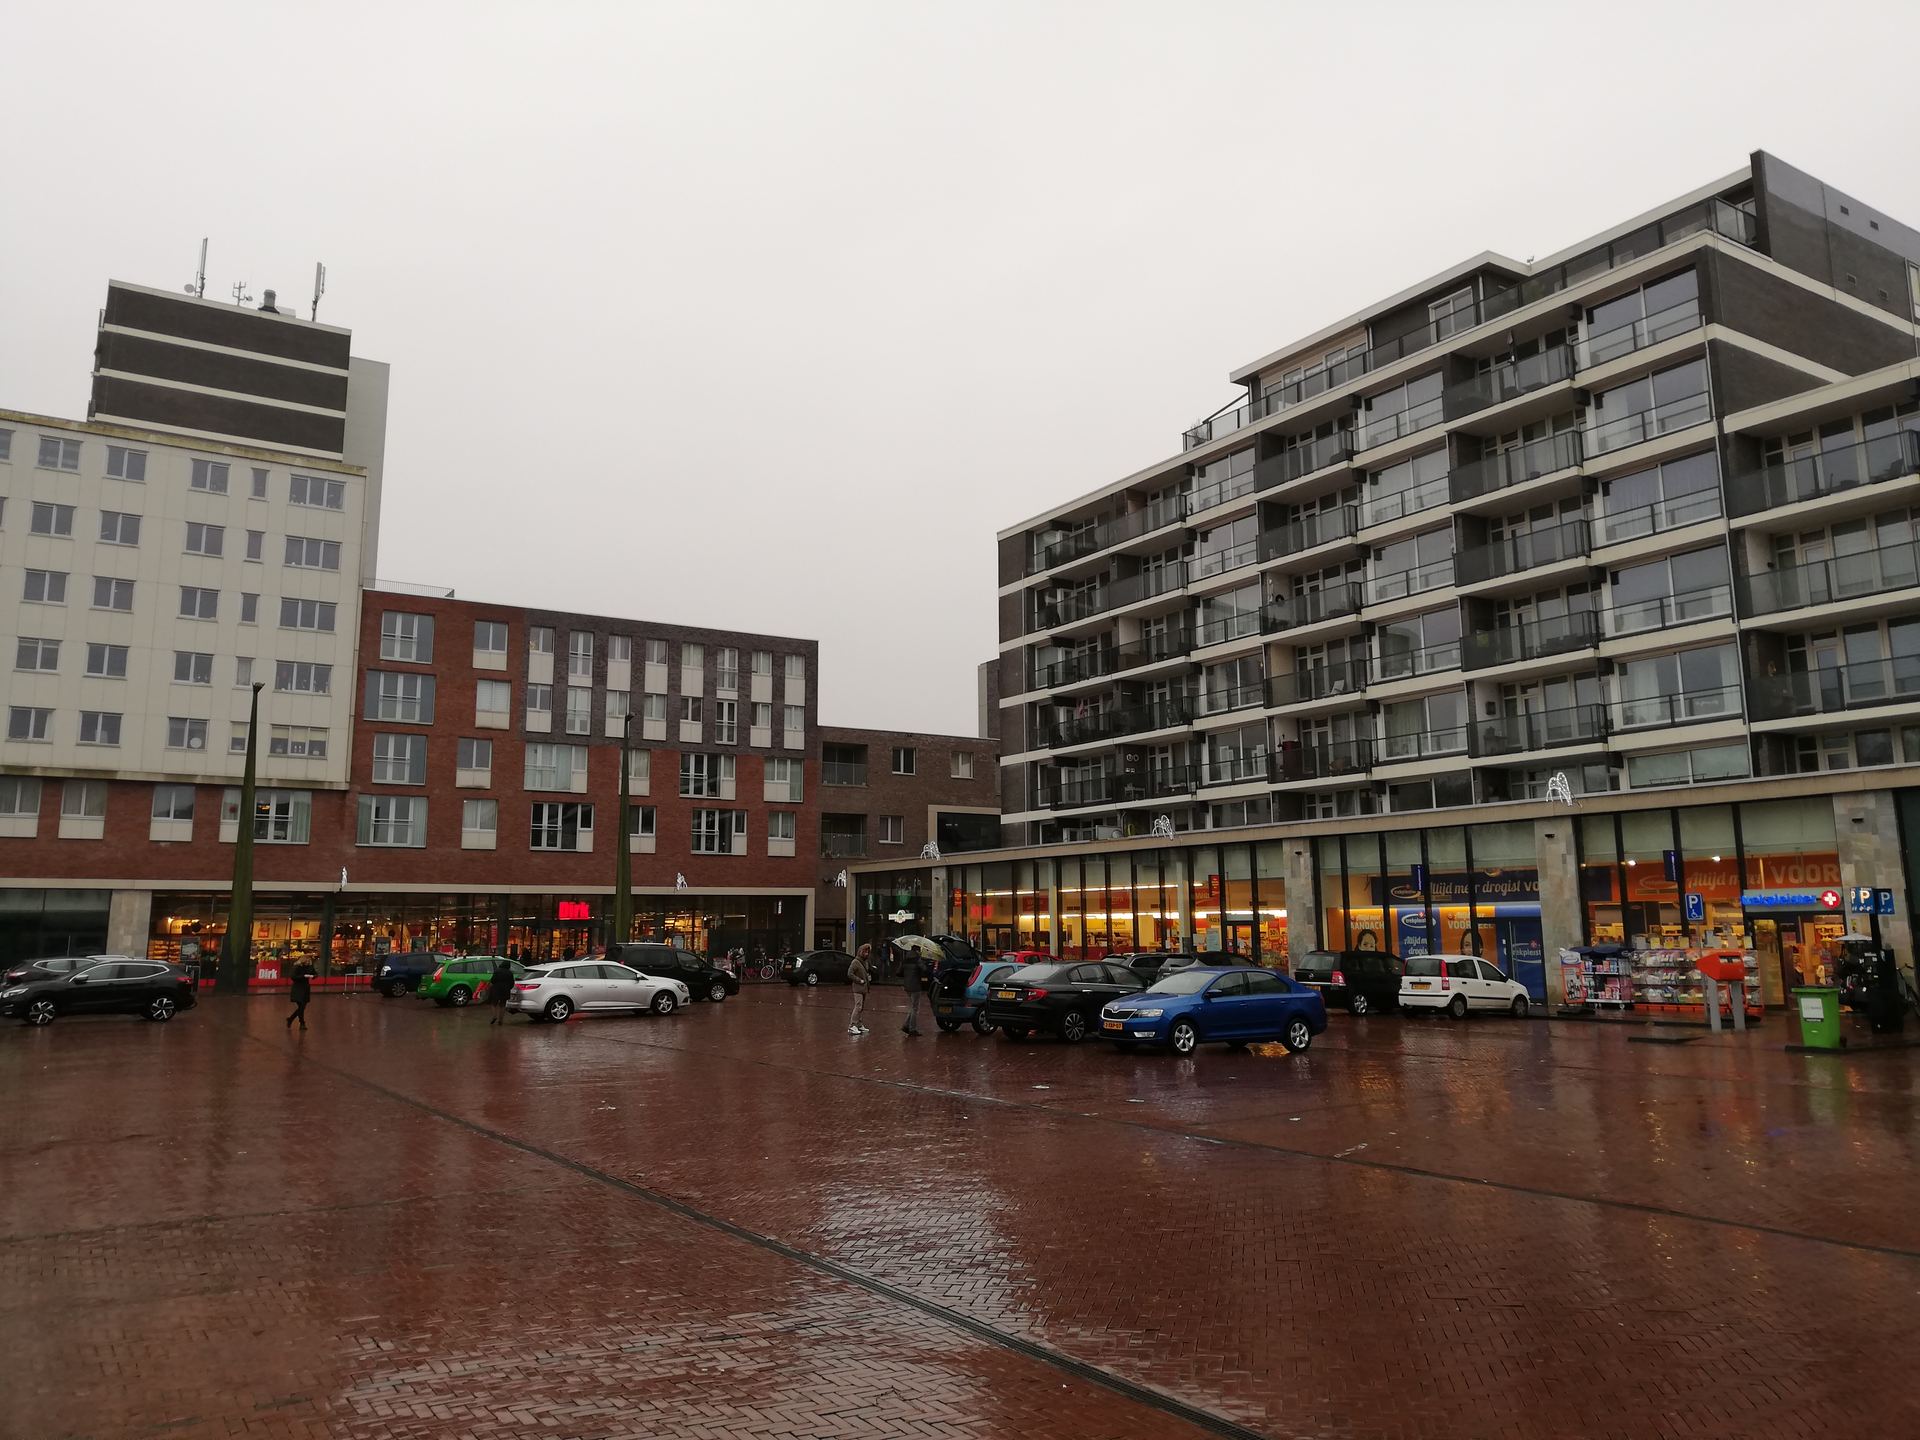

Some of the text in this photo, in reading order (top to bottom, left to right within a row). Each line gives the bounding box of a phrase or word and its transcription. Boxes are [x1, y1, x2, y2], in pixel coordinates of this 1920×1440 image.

[1771, 863, 1839, 884] VOOR
[1454, 883, 1479, 895] mer
[1482, 879, 1520, 896] drogist
[1689, 896, 1699, 908] P
[1859, 890, 1871, 904] P
[1880, 892, 1891, 906] P
[258, 968, 278, 980] Dirk
